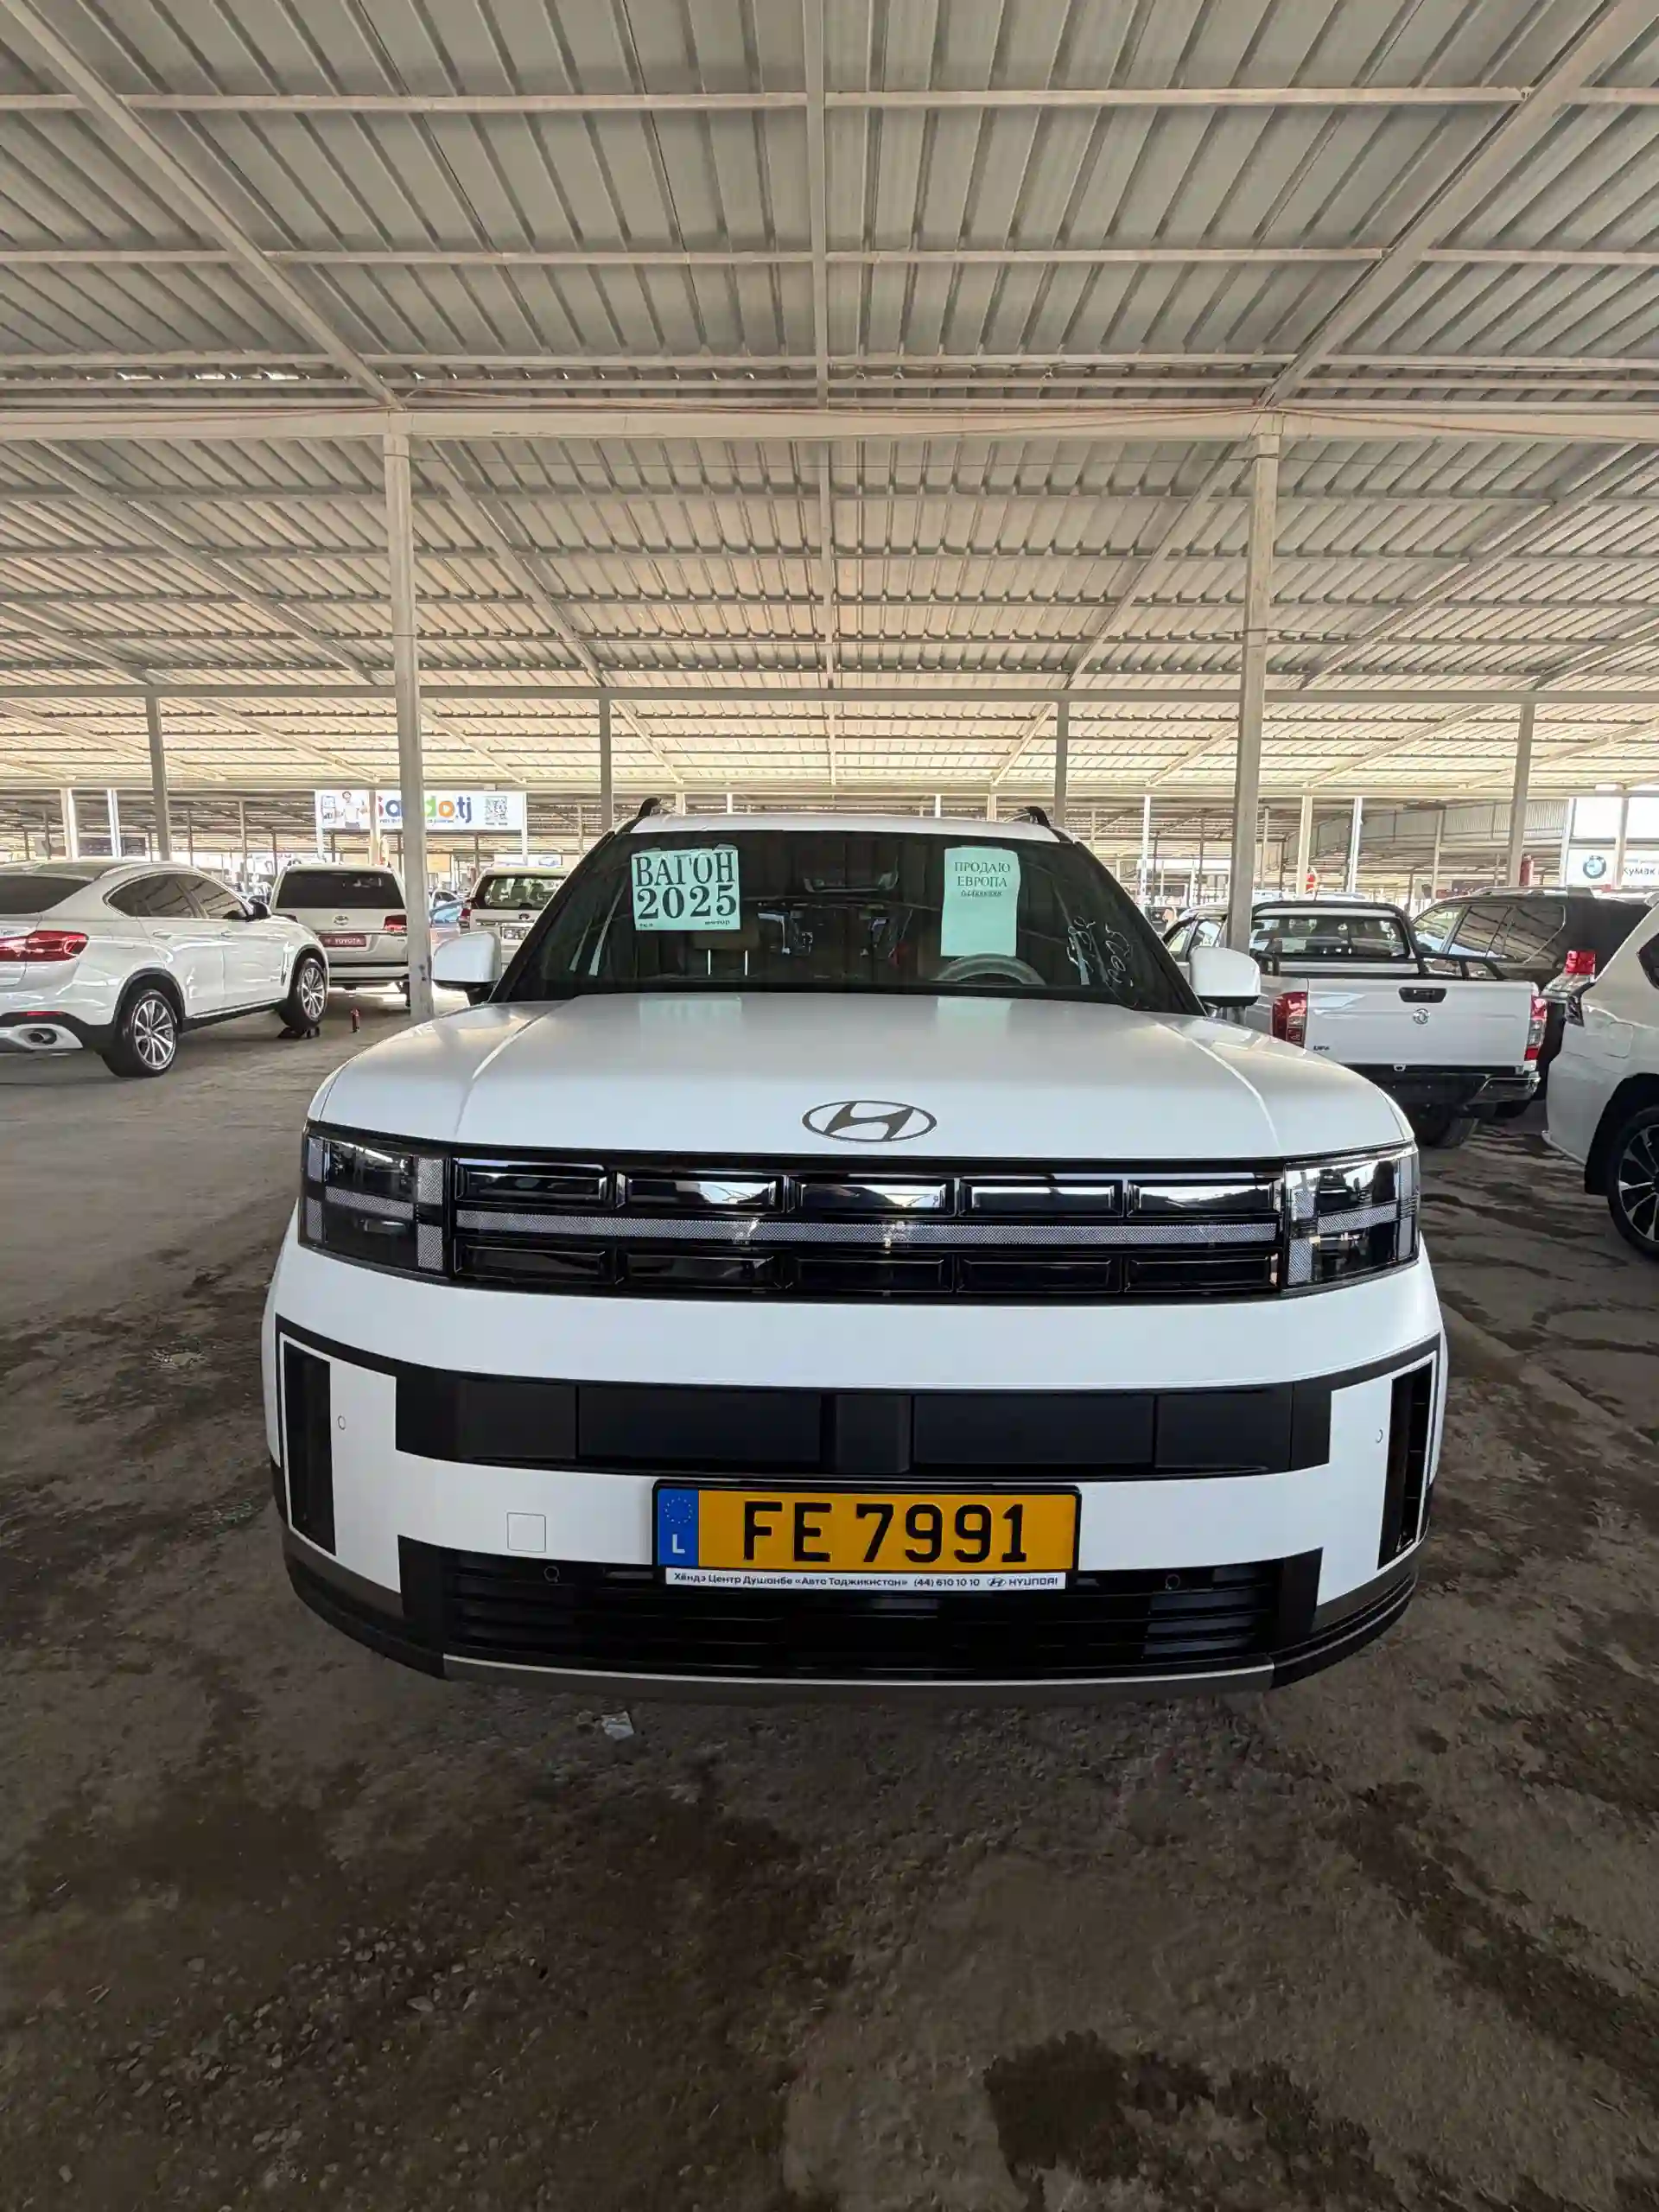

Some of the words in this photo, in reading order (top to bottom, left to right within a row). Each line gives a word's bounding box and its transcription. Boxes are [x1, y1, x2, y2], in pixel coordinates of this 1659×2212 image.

[634, 851, 735, 887] ВАГОН
[954, 861, 1010, 874] ПРОДАЮ
[957, 875, 1007, 887] ЕВРОПА
[637, 884, 737, 919] 2025
[743, 1501, 832, 1563] FE
[855, 1503, 1028, 1564] 7991
[672, 1534, 685, 1554] L
[709, 1575, 741, 1586] Центр
[913, 1579, 935, 1588] (44)
[1008, 1577, 1058, 1586] HYUNDAI
